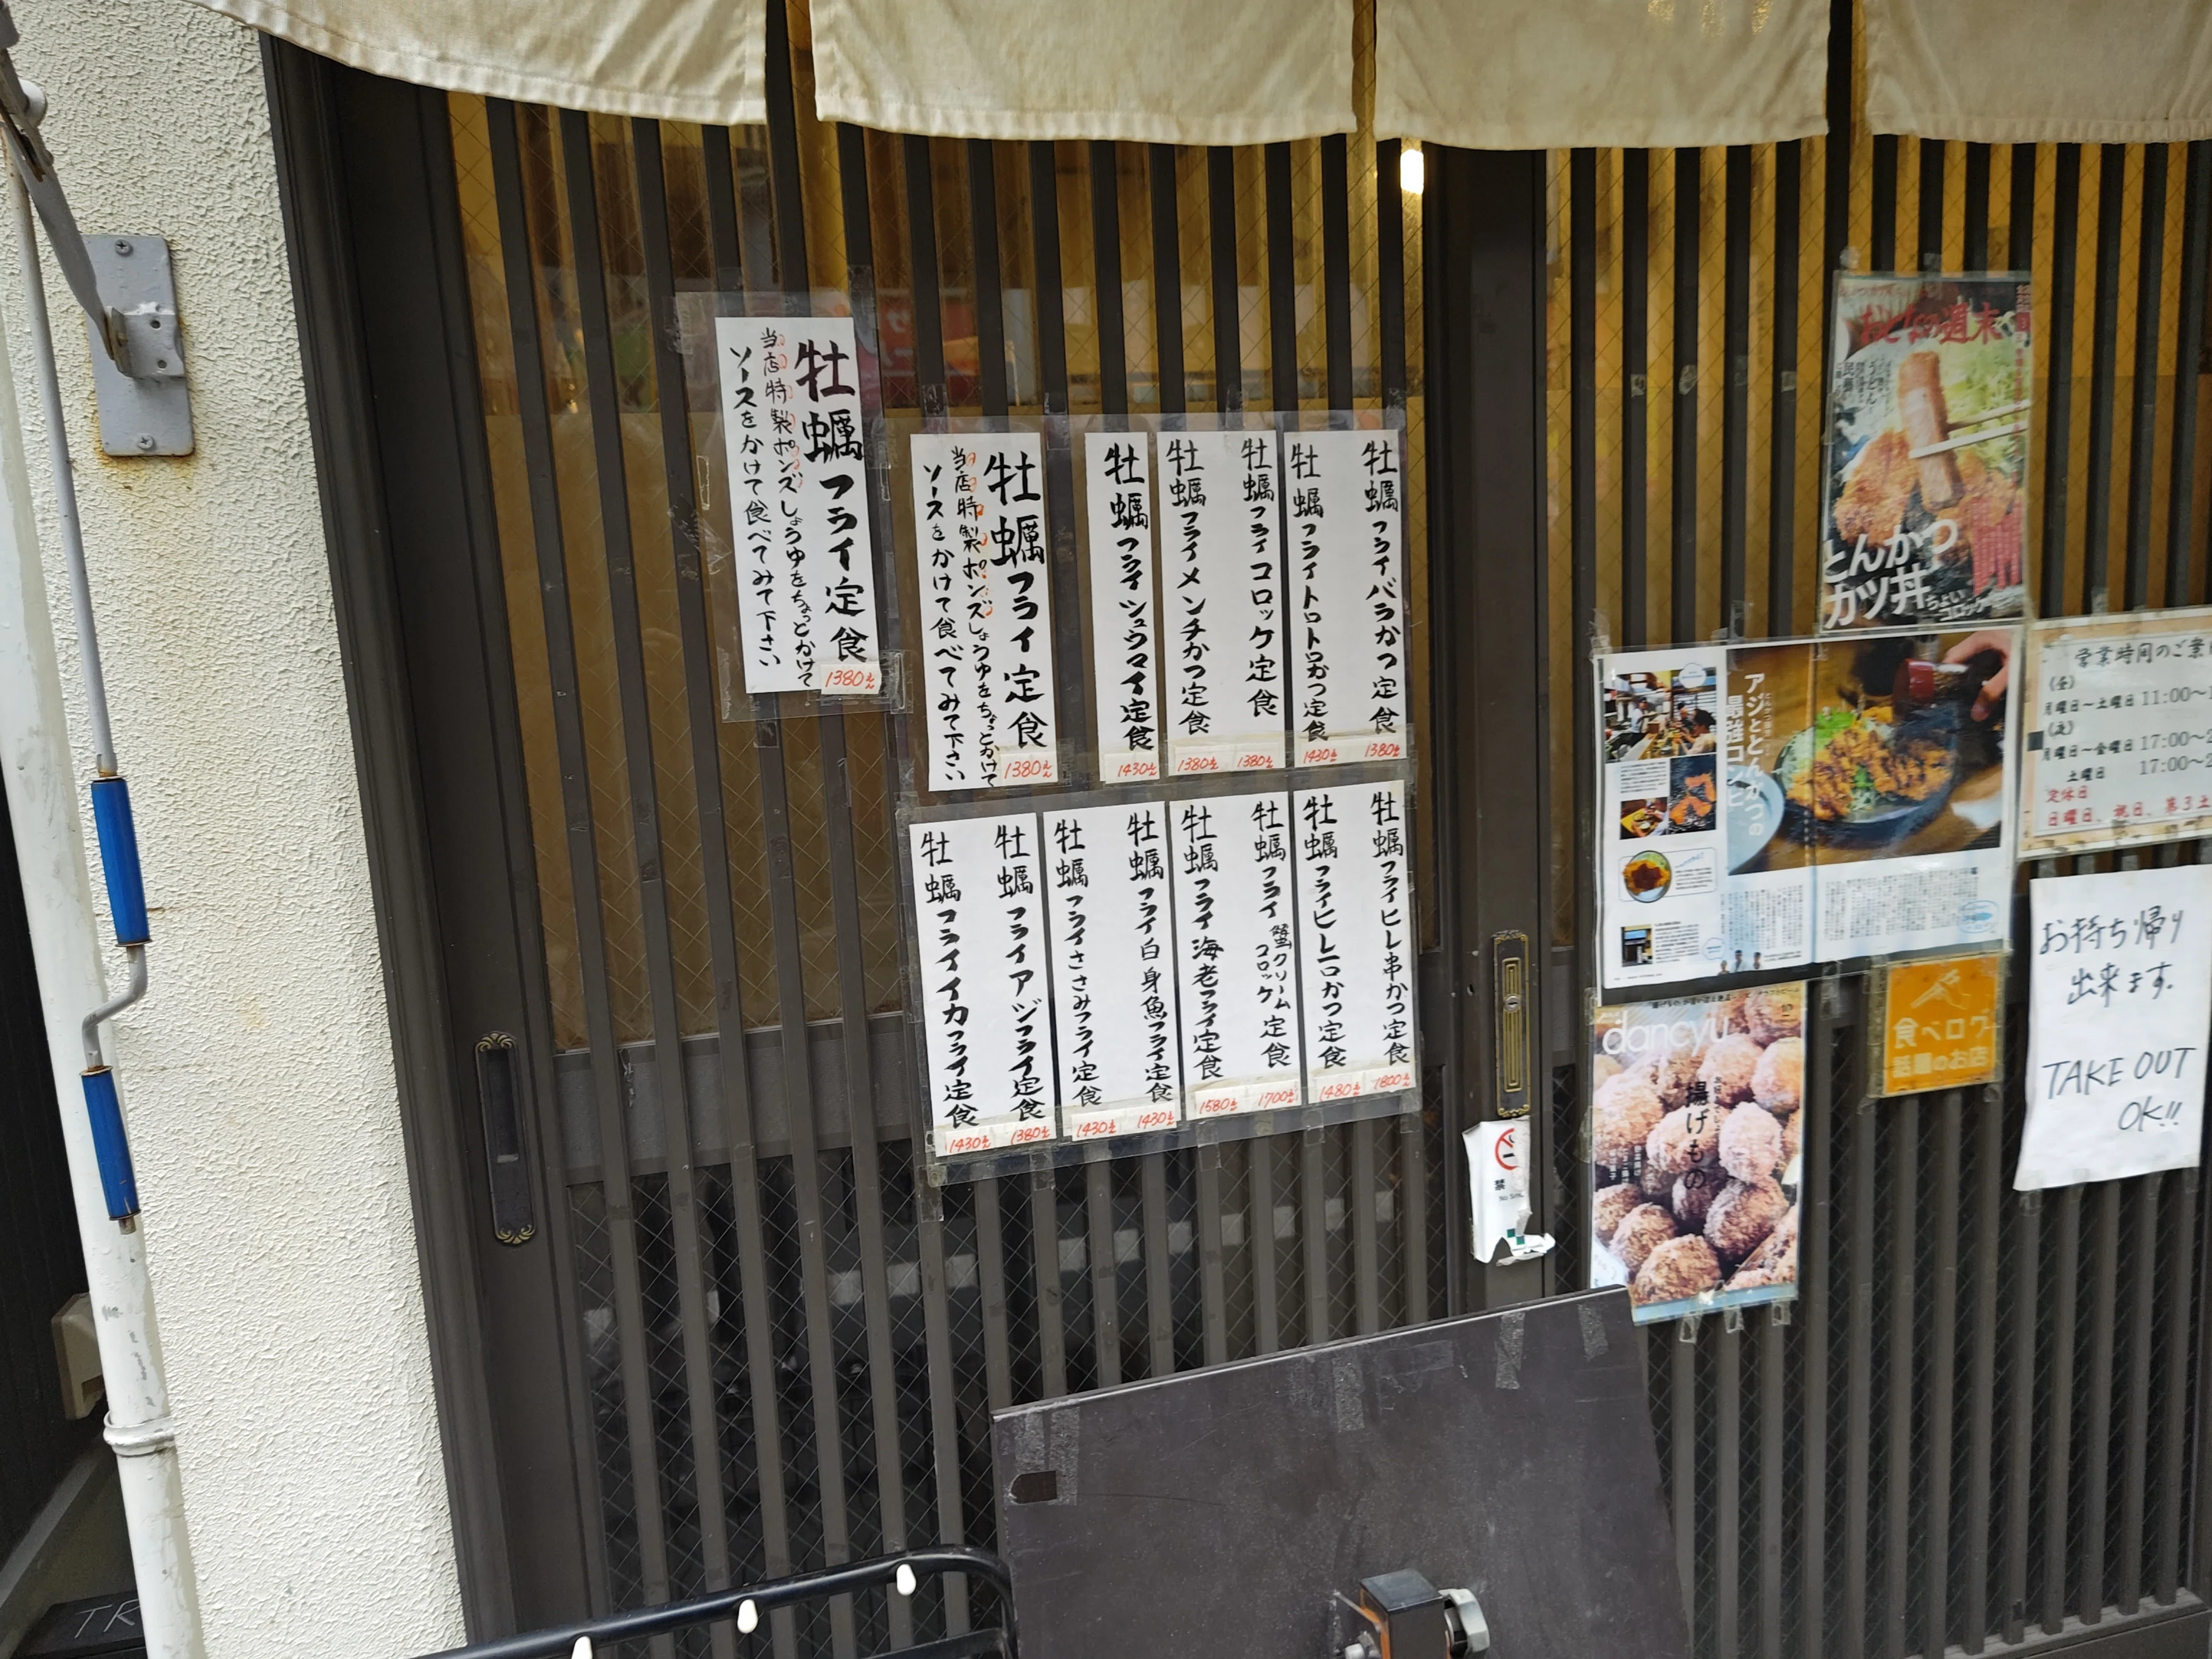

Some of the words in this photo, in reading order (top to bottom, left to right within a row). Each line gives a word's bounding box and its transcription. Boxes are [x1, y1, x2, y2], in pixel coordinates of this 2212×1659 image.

[730, 346, 782, 667] ソースをかけて食べてみて下さい
[794, 339, 869, 663] 牡蠣フライ定食
[923, 463, 965, 782] ソースをかけて食べてみて下さい
[983, 451, 1049, 748] 牡蠣フライ定食
[1103, 443, 1157, 751] 牡蠣フライシュウマイ定食
[1166, 439, 1211, 735] 牡蠣フライメンチかつ定食
[1241, 437, 1279, 717] 牡蠣フライコロッケ定食
[1361, 440, 1401, 734] 牡蠣フライバラかつ定食
[1824, 519, 1958, 584] とんかつ
[2075, 637, 2212, 668] 営業時間のご案
[920, 831, 979, 1129] 牡蠣フライイカフライ定食
[995, 824, 1046, 1122] 牡蠣フライアジフライ定食
[1127, 810, 1172, 1103] 牡蠣フライ白身魚フライ定食
[1181, 804, 1224, 1080] 牡蠣フライ海老フライ定食
[1602, 1010, 1729, 1057] dancyu
[1892, 1008, 1990, 1049] 食べログ
[2040, 905, 2184, 954] お持ち帰り
[2042, 1057, 2124, 1099] TAKE
[2133, 1047, 2197, 1080] OUT
[1685, 1081, 1709, 1190] 揚げもの
